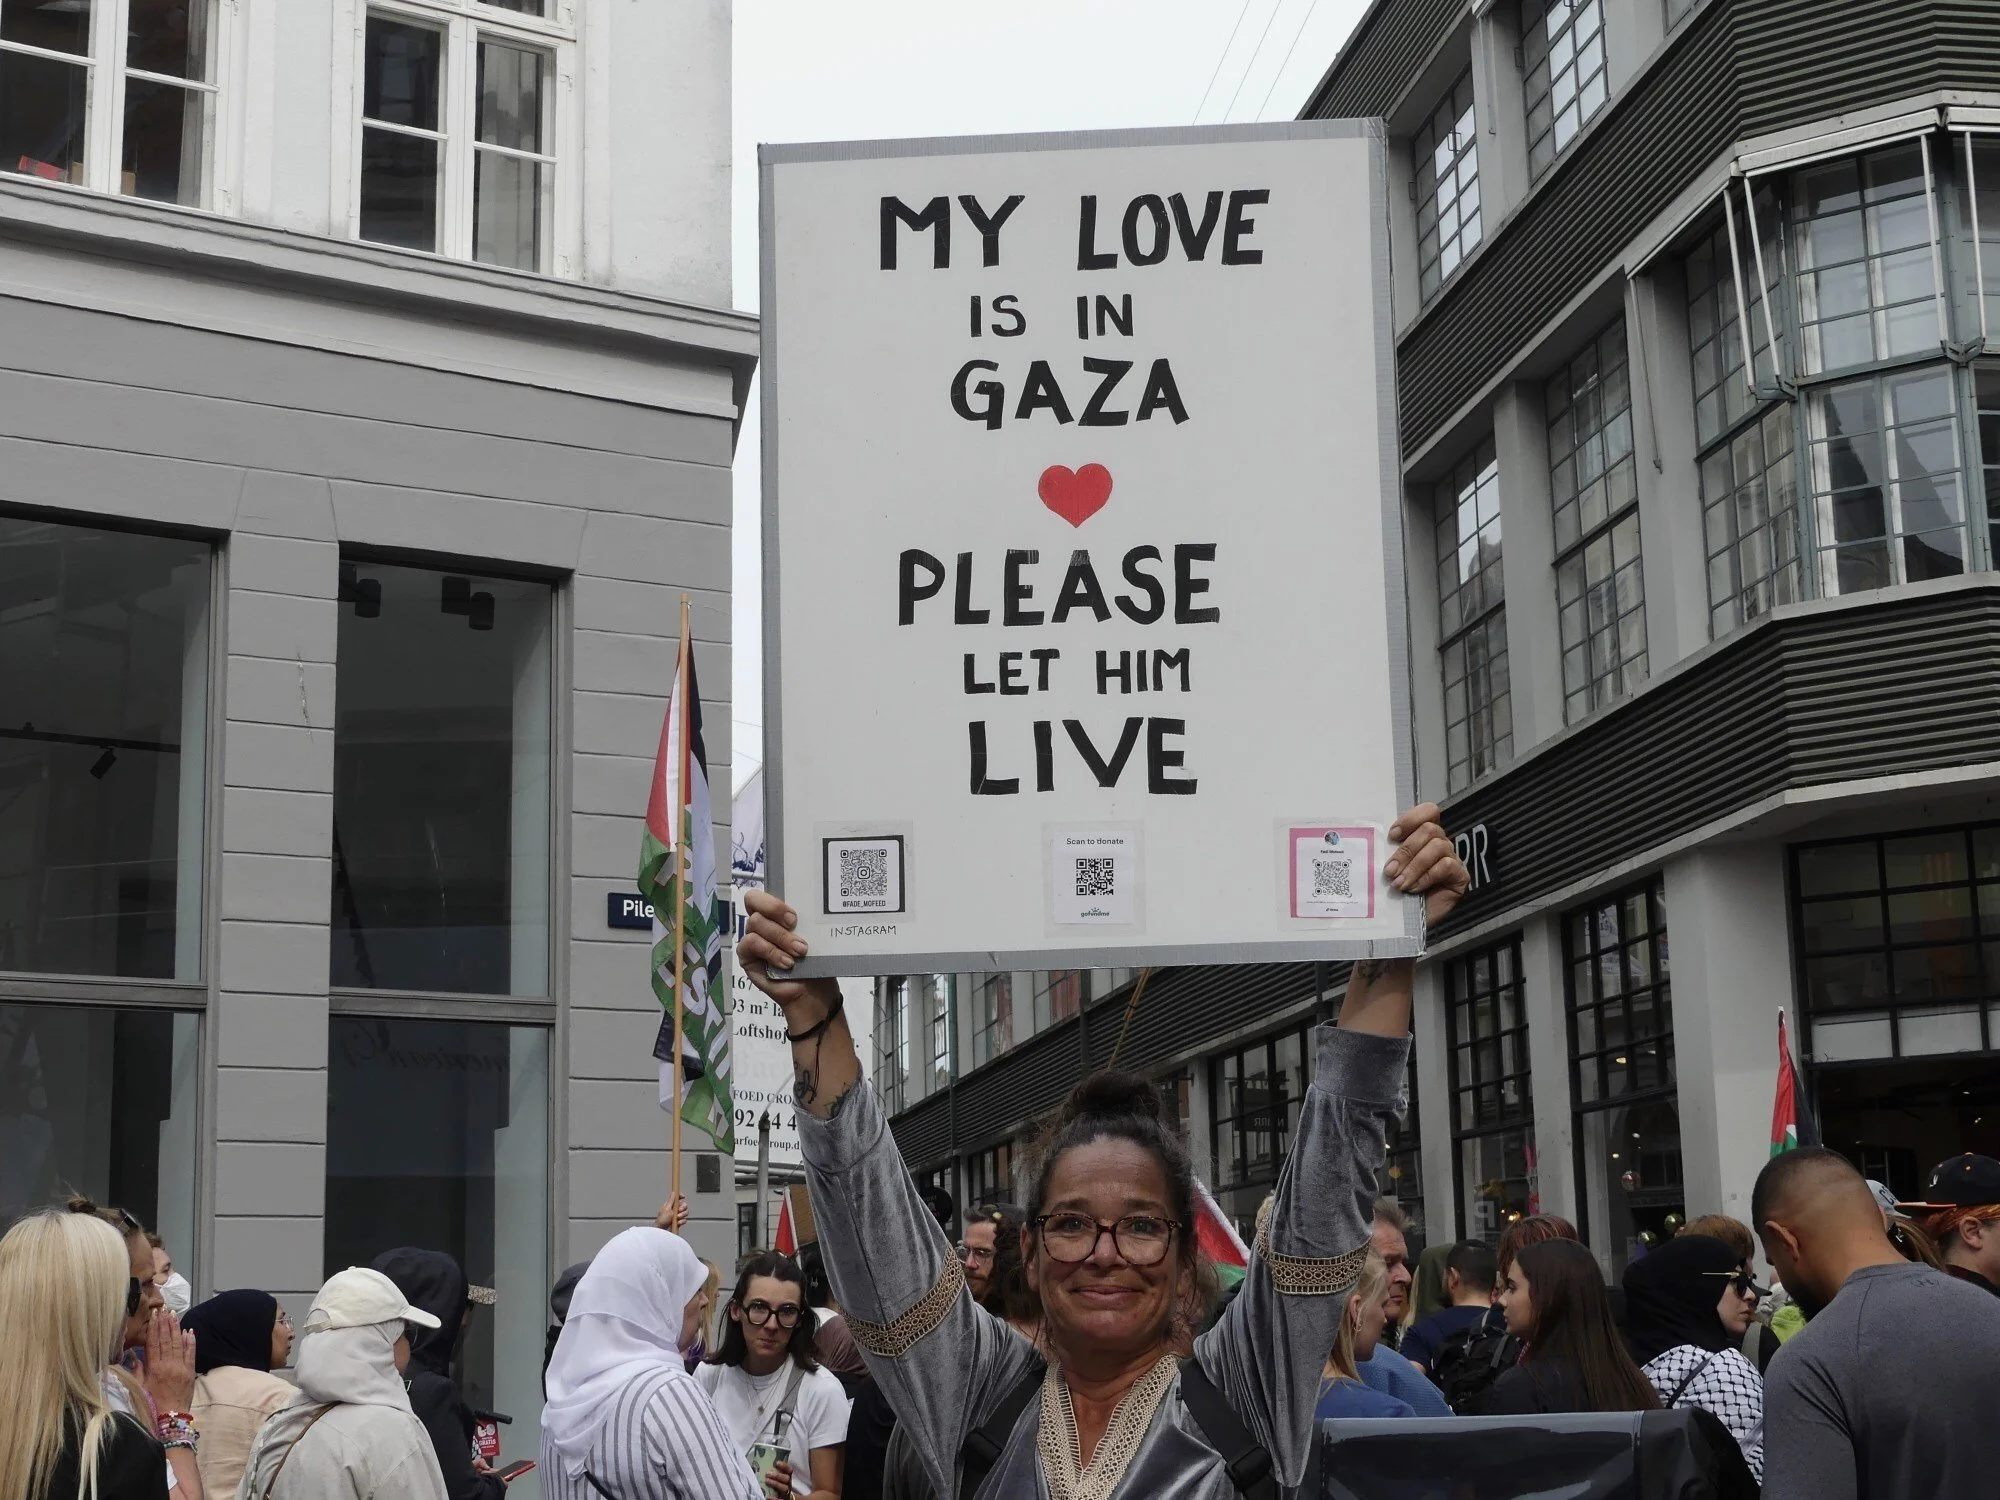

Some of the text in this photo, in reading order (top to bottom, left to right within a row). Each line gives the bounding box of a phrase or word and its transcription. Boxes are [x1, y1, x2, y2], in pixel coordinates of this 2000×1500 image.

[880, 189, 1270, 270] MY LOVE
[970, 294, 1134, 339] IS IN
[950, 356, 1190, 430] GAZA
[899, 543, 1220, 626] PLEASE
[963, 648, 1191, 695] LET HIM
[969, 716, 1198, 795] LIVE
[1066, 837, 1086, 845] Scan
[623, 900, 655, 918] Pile
[830, 925, 897, 938] INSTAGRAM
[766, 1093, 794, 1105] CRO
[735, 1109, 755, 1127] 92
[734, 1135, 800, 1151] arfoeroup.d
